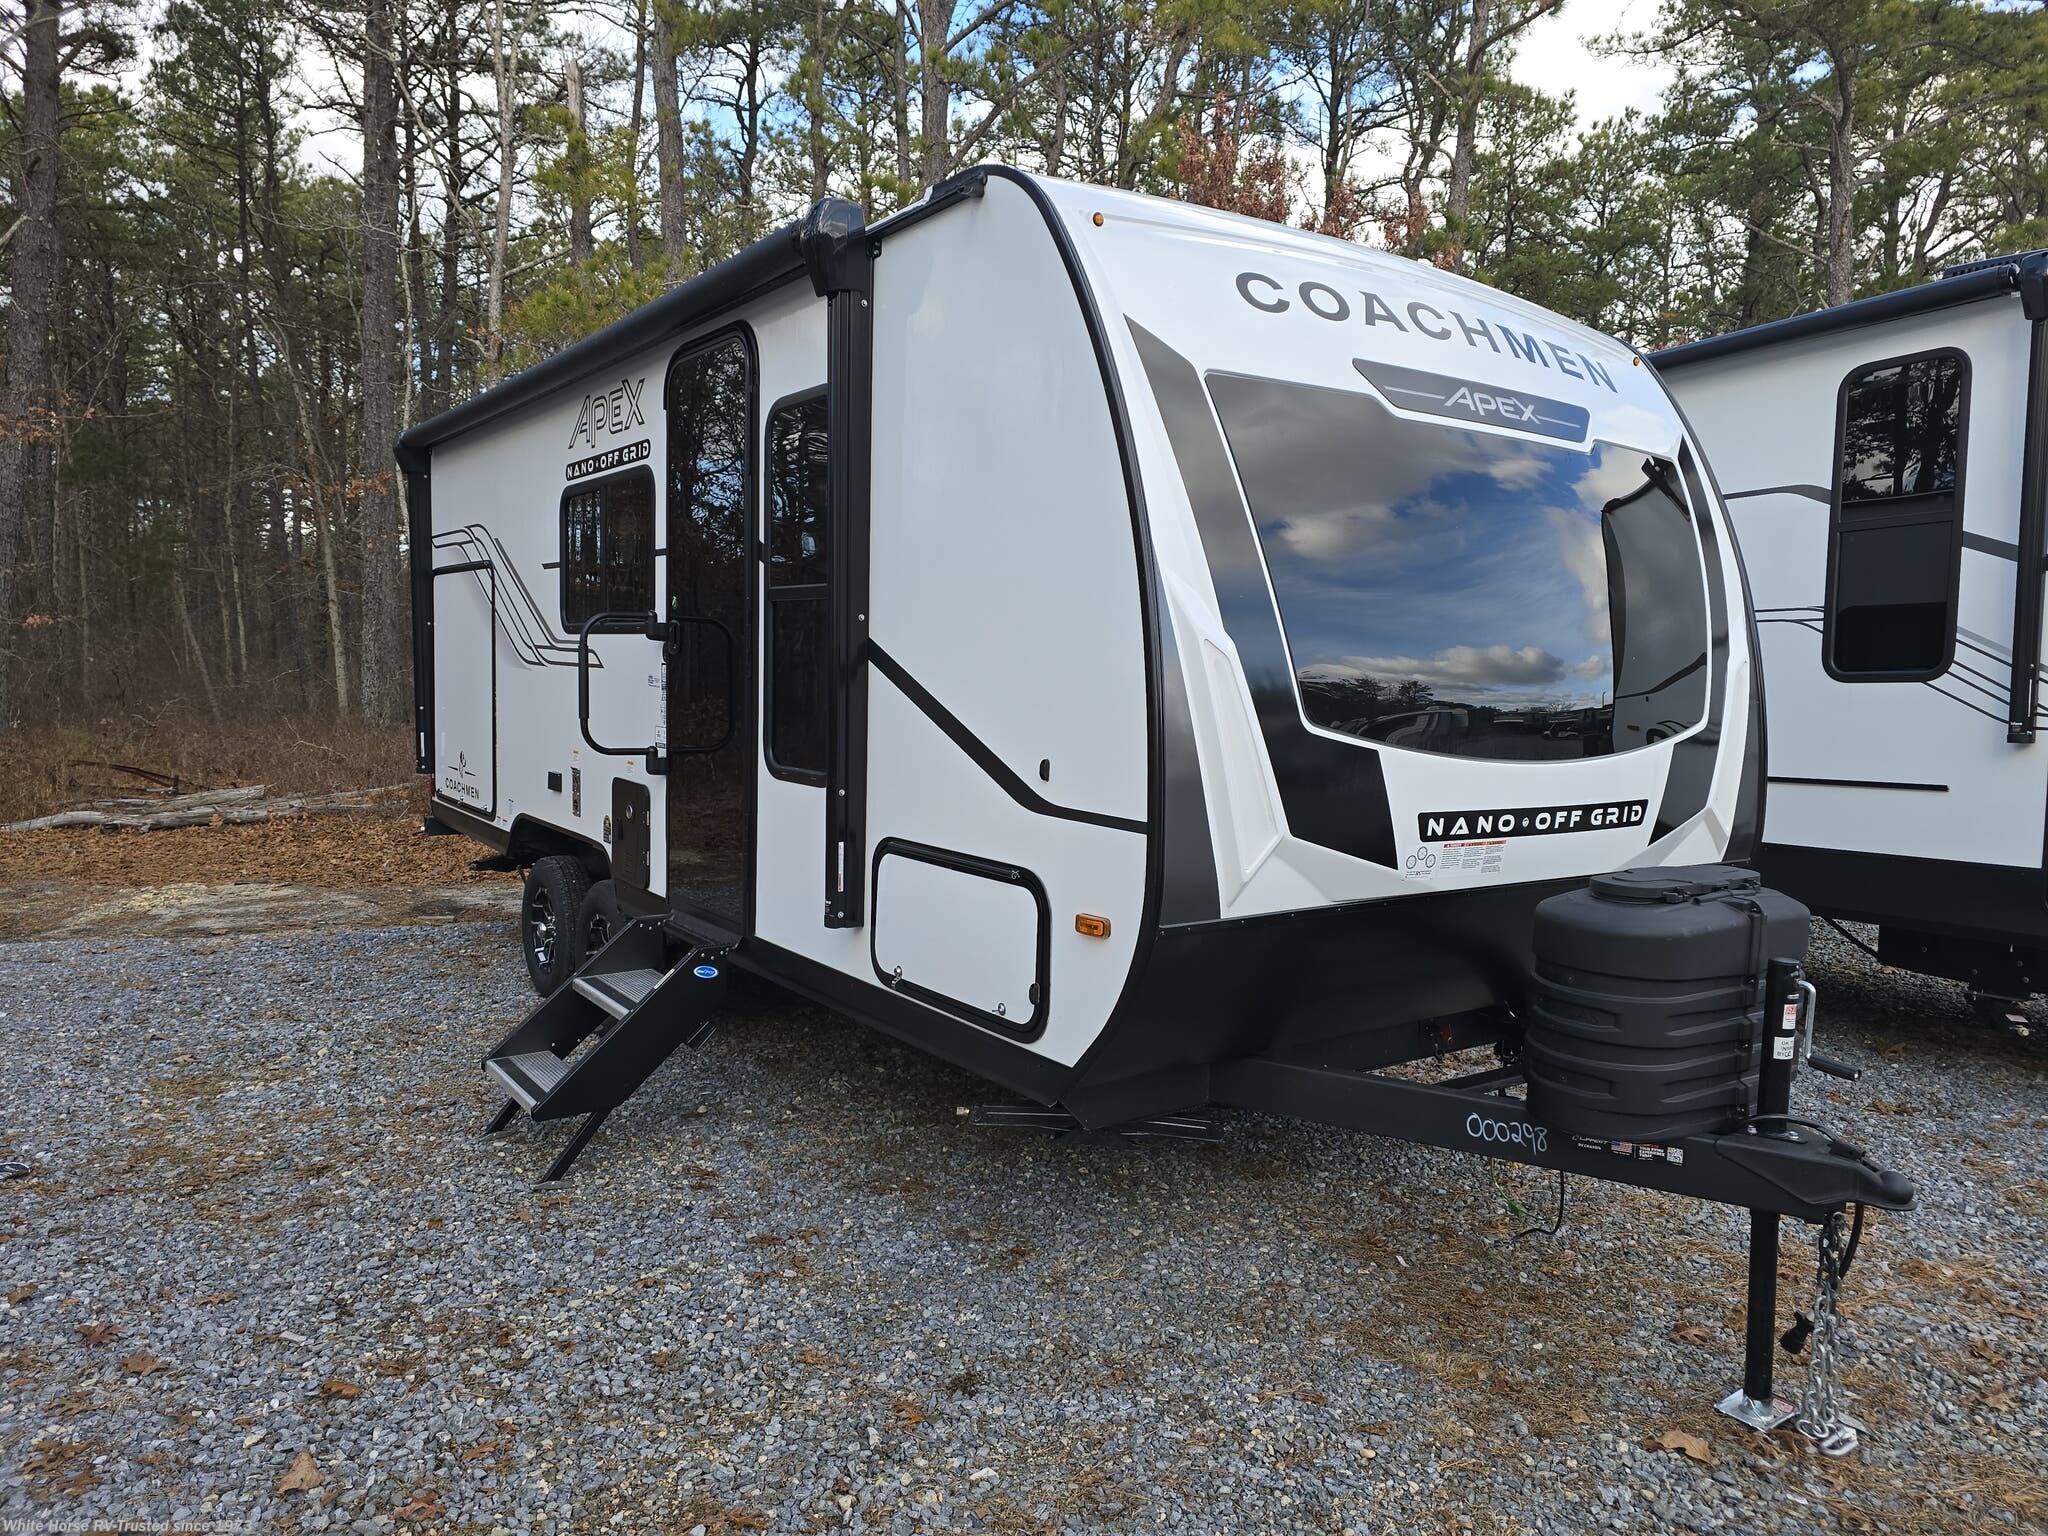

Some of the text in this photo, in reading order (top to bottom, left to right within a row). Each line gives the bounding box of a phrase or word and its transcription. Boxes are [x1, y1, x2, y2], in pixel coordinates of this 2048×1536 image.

[1235, 272, 1618, 393] COACHMEN
[1444, 387, 1541, 425] APEX
[567, 442, 649, 479] NANO OFF GRID
[445, 777, 479, 800] COACHMEN
[1427, 805, 1642, 837] NANO OFF GRID
[1466, 1112, 1548, 1155] 000298
